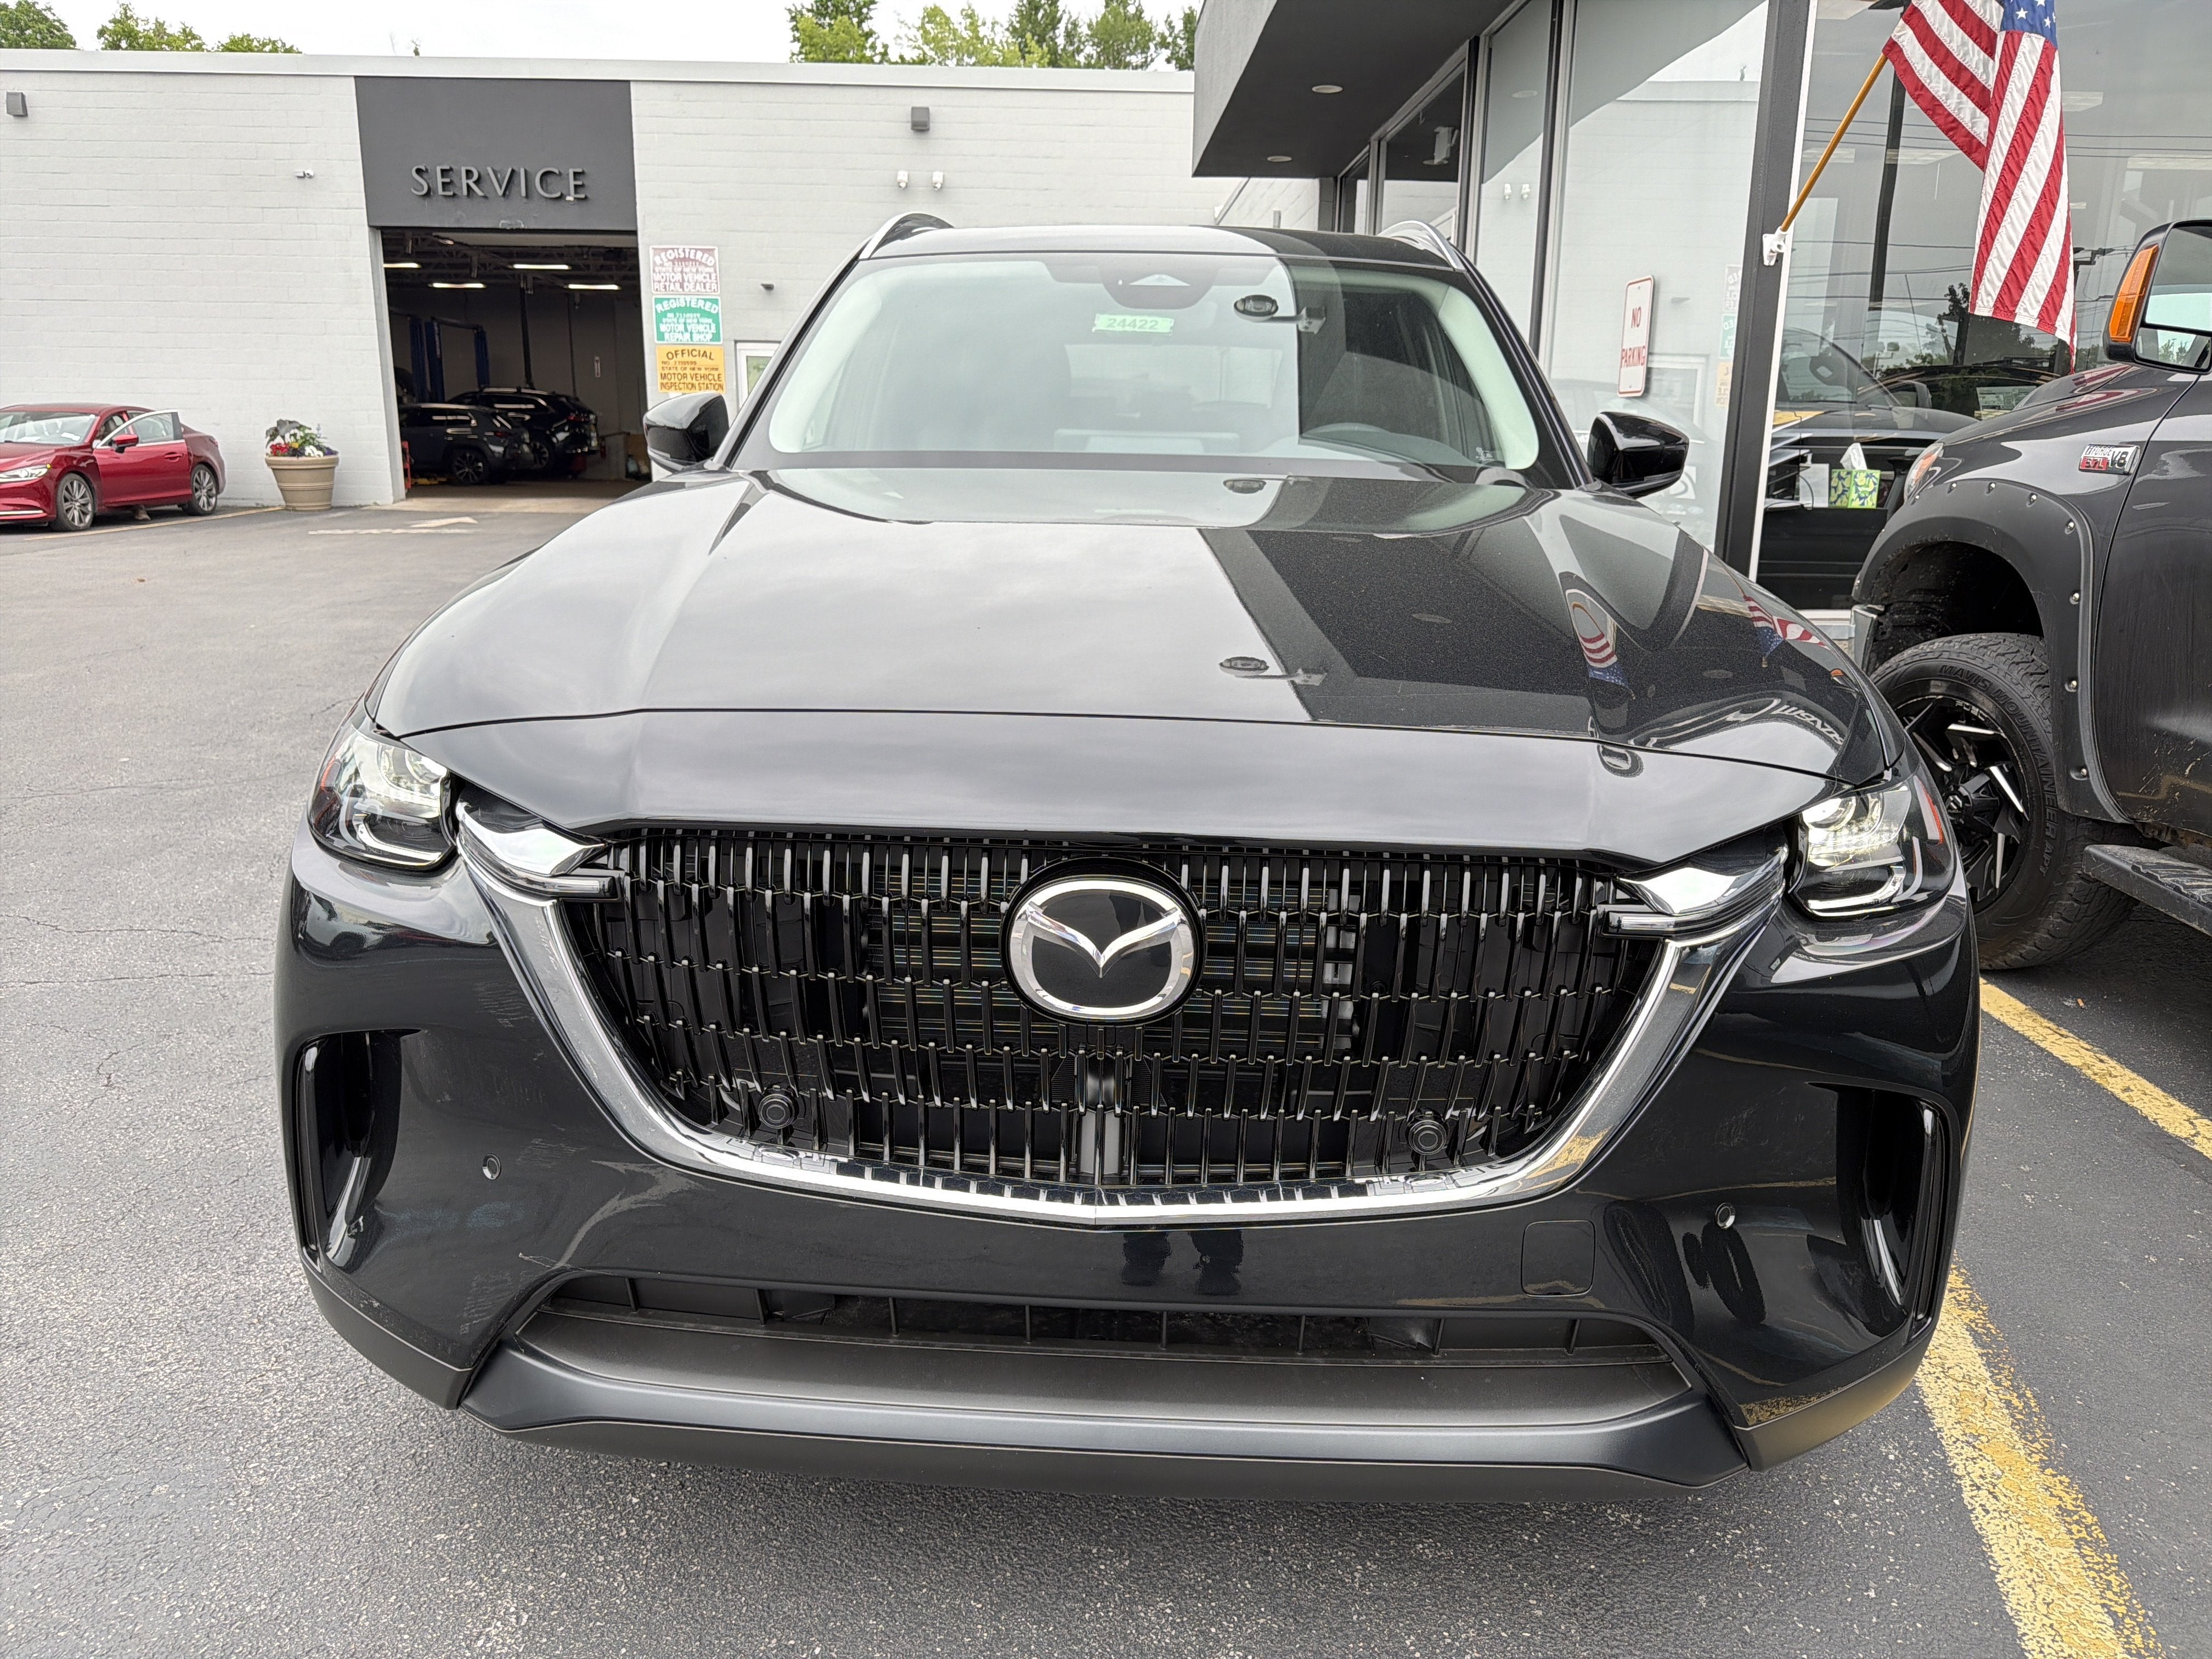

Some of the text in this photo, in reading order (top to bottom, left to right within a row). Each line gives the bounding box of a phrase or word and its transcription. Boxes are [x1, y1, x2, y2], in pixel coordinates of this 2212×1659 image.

[410, 165, 586, 199] SERVICE
[654, 249, 715, 266] REGISTERED
[653, 273, 716, 283] MOTOR VEHICLE
[654, 282, 718, 292] RETAIL DEALER
[656, 297, 719, 314] REGISTERED
[1107, 318, 1159, 330] 24422
[1631, 306, 1641, 328] NO
[666, 348, 715, 360] OFFICIAL
[1621, 345, 1646, 368] PARKING
[660, 373, 722, 382] MOTOR VEHICLE
[660, 382, 724, 391] INSPECTION STATION
[2111, 450, 2129, 468] V8
[1939, 665, 1993, 691] MAVIS
[1991, 689, 2058, 839] MOUNTAINEER
